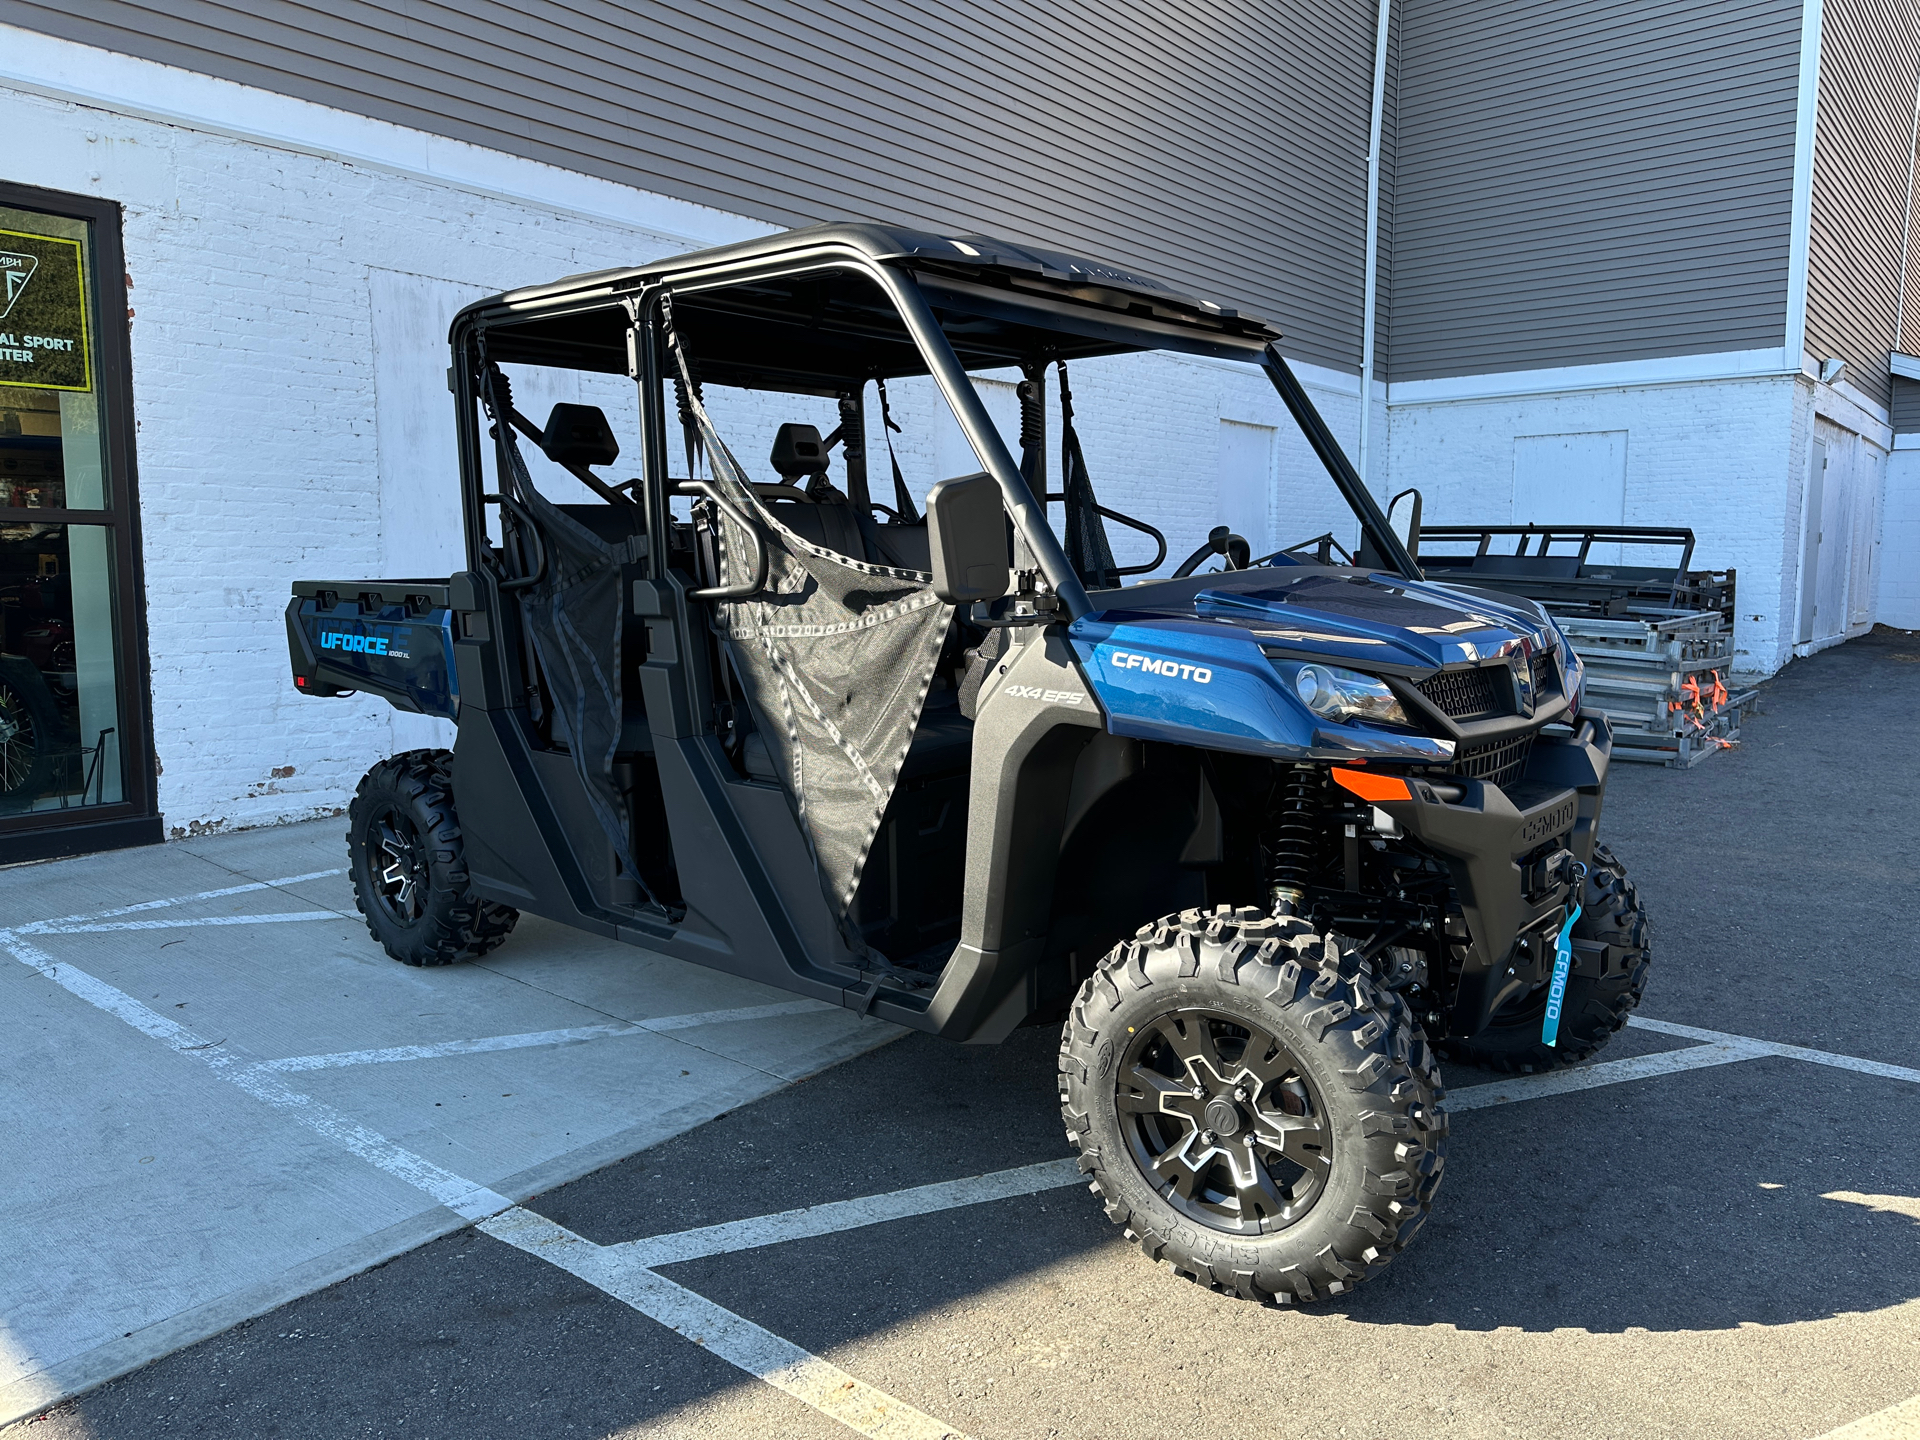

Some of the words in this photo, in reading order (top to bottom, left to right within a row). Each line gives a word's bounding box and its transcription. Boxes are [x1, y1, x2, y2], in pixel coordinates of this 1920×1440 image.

[24, 335, 74, 351] SPORT
[321, 632, 389, 655] UFORCE
[388, 650, 403, 658] 1000
[1111, 651, 1212, 684] CFMOTO
[1522, 801, 1574, 844] CFMOTO
[1547, 949, 1570, 1020] CFMOTO
